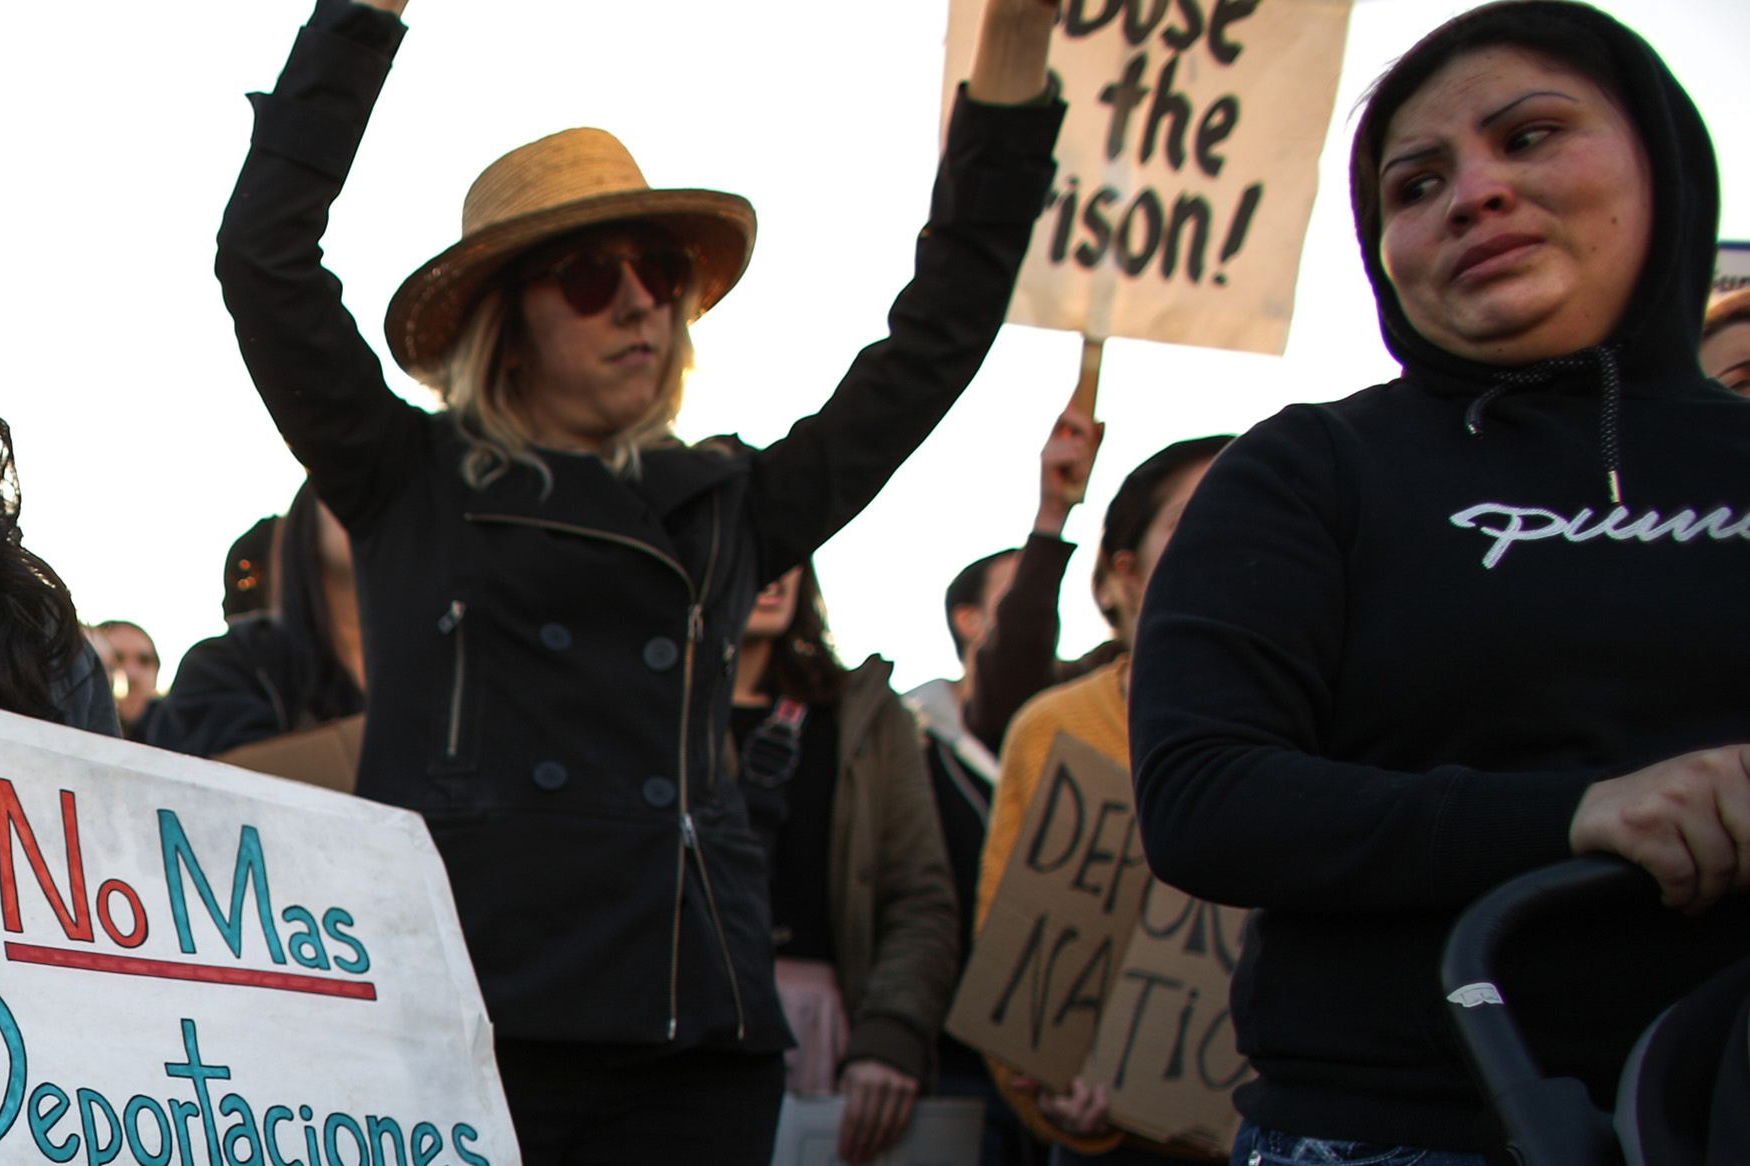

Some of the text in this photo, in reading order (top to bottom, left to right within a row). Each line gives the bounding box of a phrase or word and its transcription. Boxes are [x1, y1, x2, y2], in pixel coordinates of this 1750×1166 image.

[1098, 50, 1241, 178] the
[1045, 176, 1264, 287] ison!
[157, 808, 370, 974] Mas
